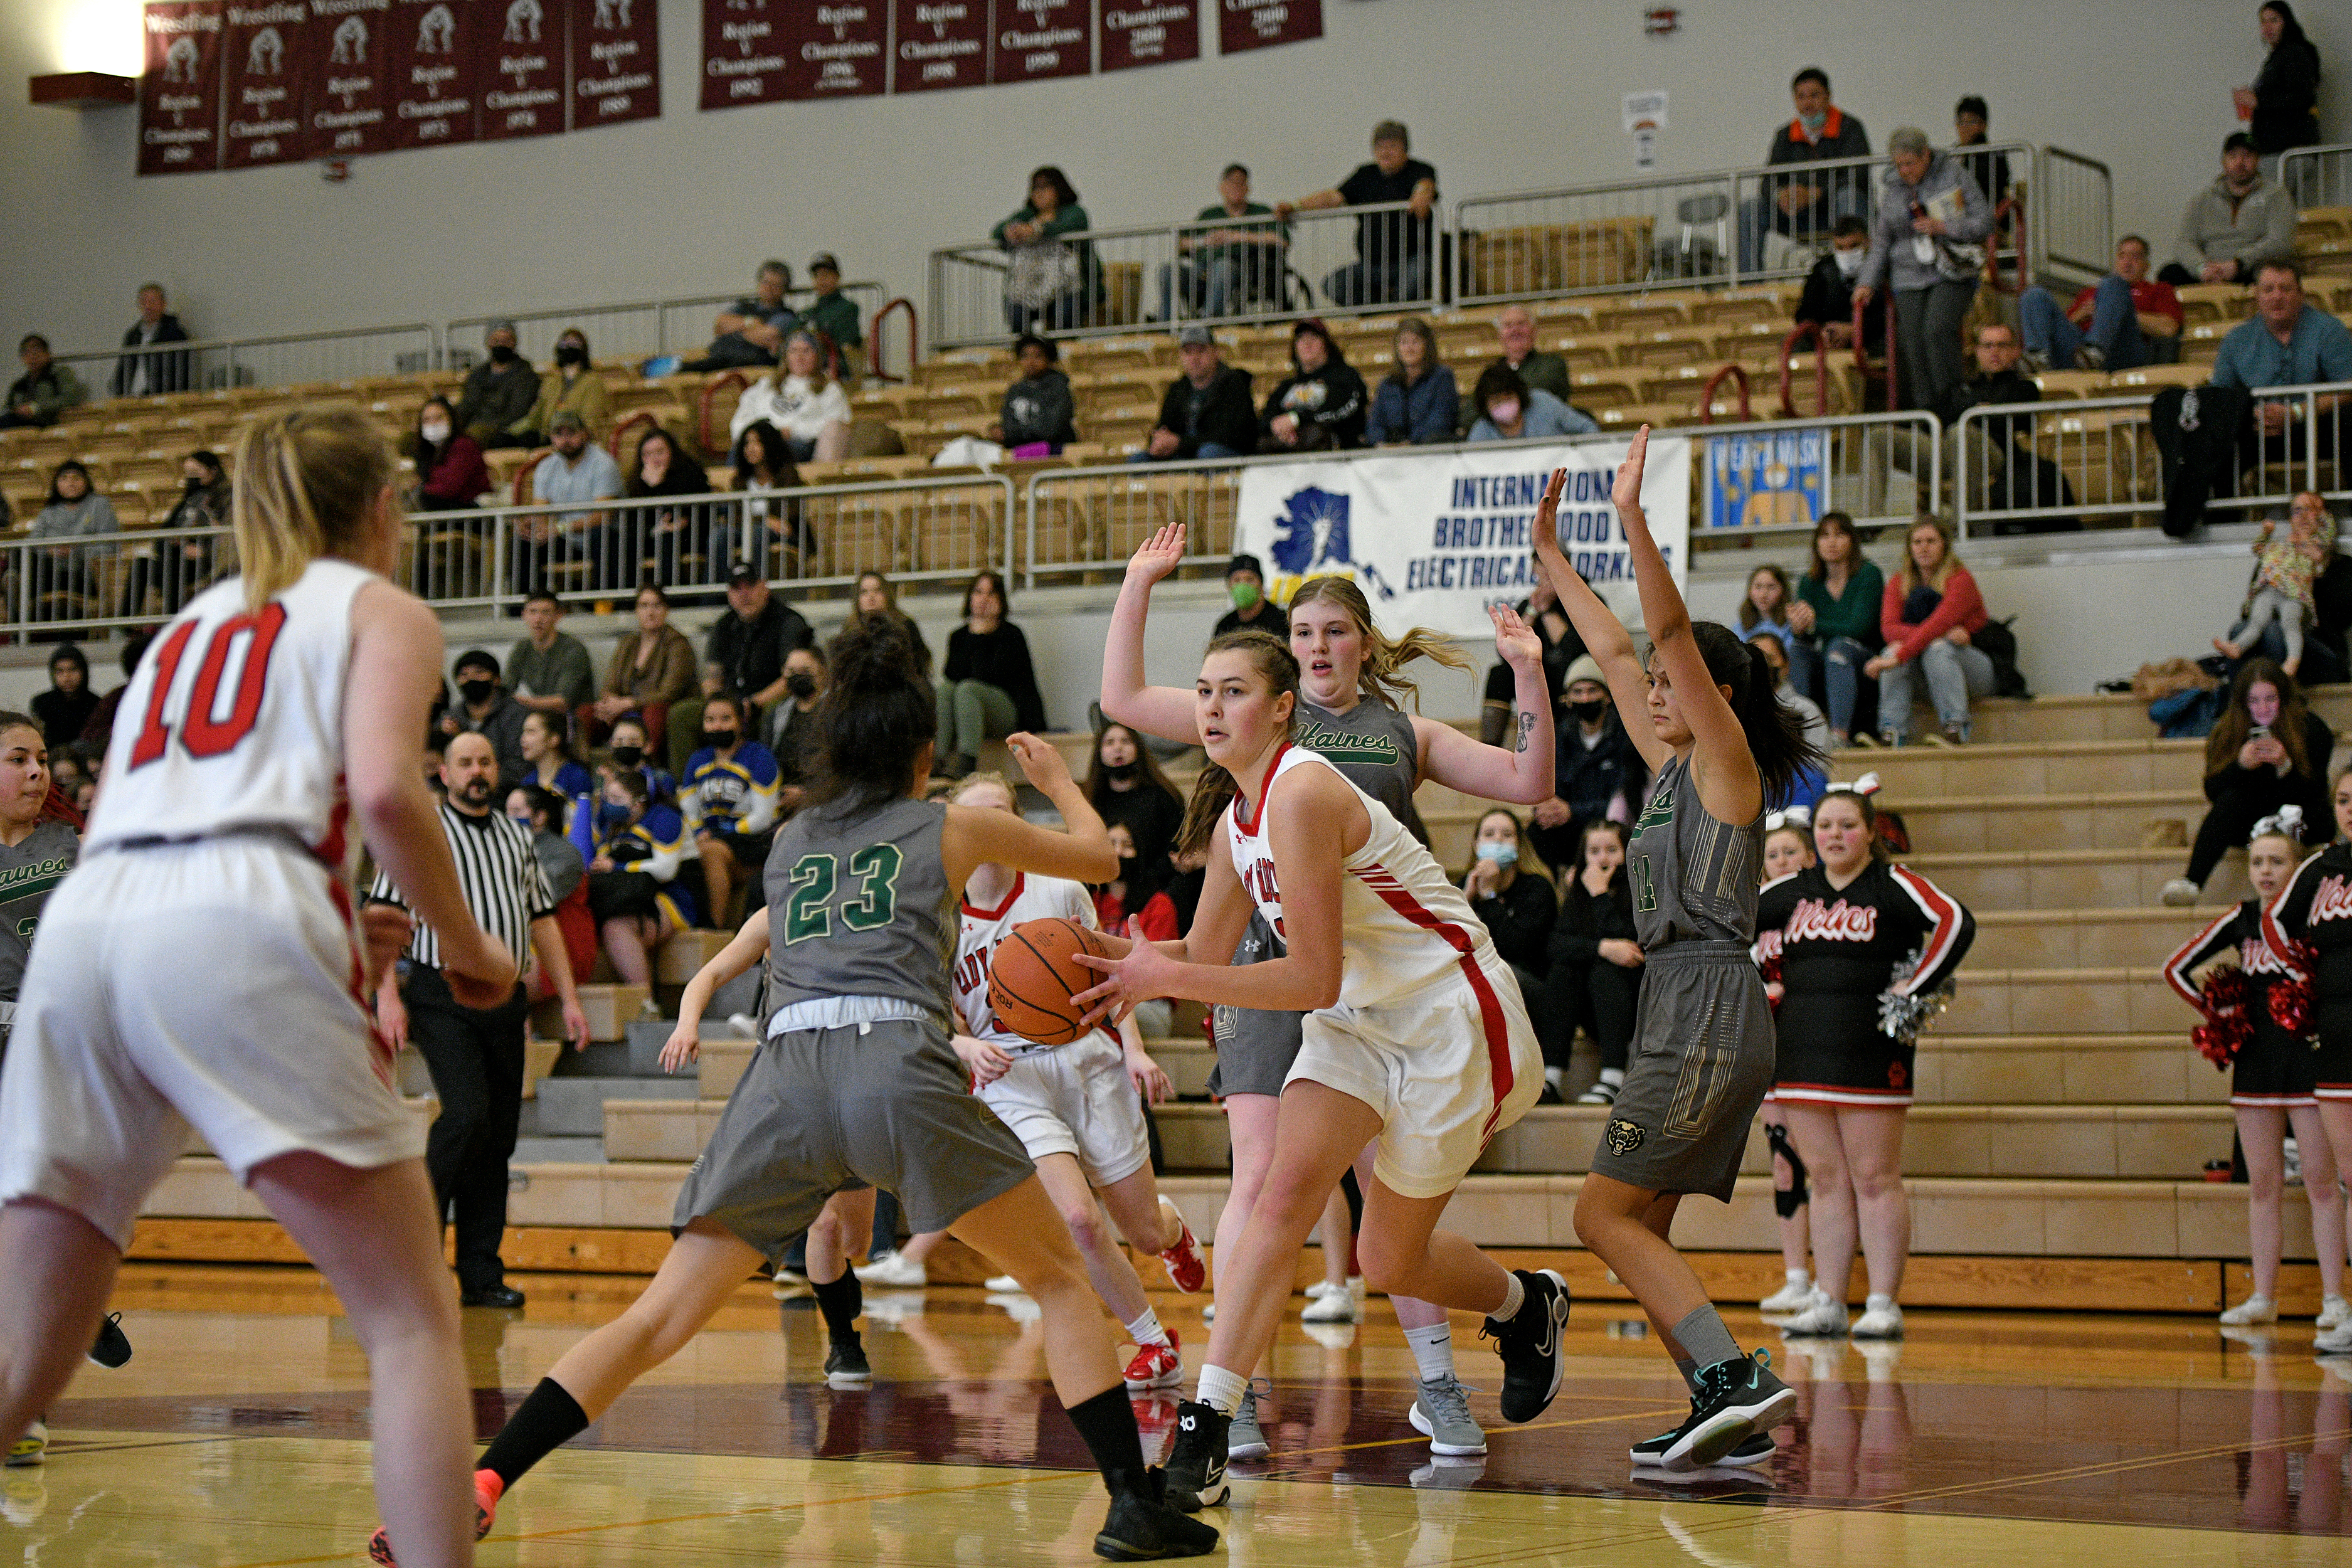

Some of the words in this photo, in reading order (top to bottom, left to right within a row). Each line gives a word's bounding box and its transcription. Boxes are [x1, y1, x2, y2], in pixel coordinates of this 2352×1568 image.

[1106, 5, 1190, 31] Champions
[900, 40, 981, 60] Champions
[1000, 26, 1082, 50] Champions
[801, 41, 881, 61] Champions
[707, 56, 785, 77] Champions
[578, 73, 652, 97] Champions
[398, 98, 470, 119] Champions
[486, 88, 560, 110] Champions
[230, 119, 299, 137] Champions
[314, 108, 383, 129] Champions
[144, 127, 212, 145] Champions
[1434, 512, 1608, 547] BROTHEOOD
[128, 601, 287, 771] 10
[1293, 721, 1396, 750] Haines
[0, 857, 73, 887] aines
[1633, 855, 1656, 912] 14
[785, 842, 904, 946] 23
[1783, 898, 1878, 944] Wolves
